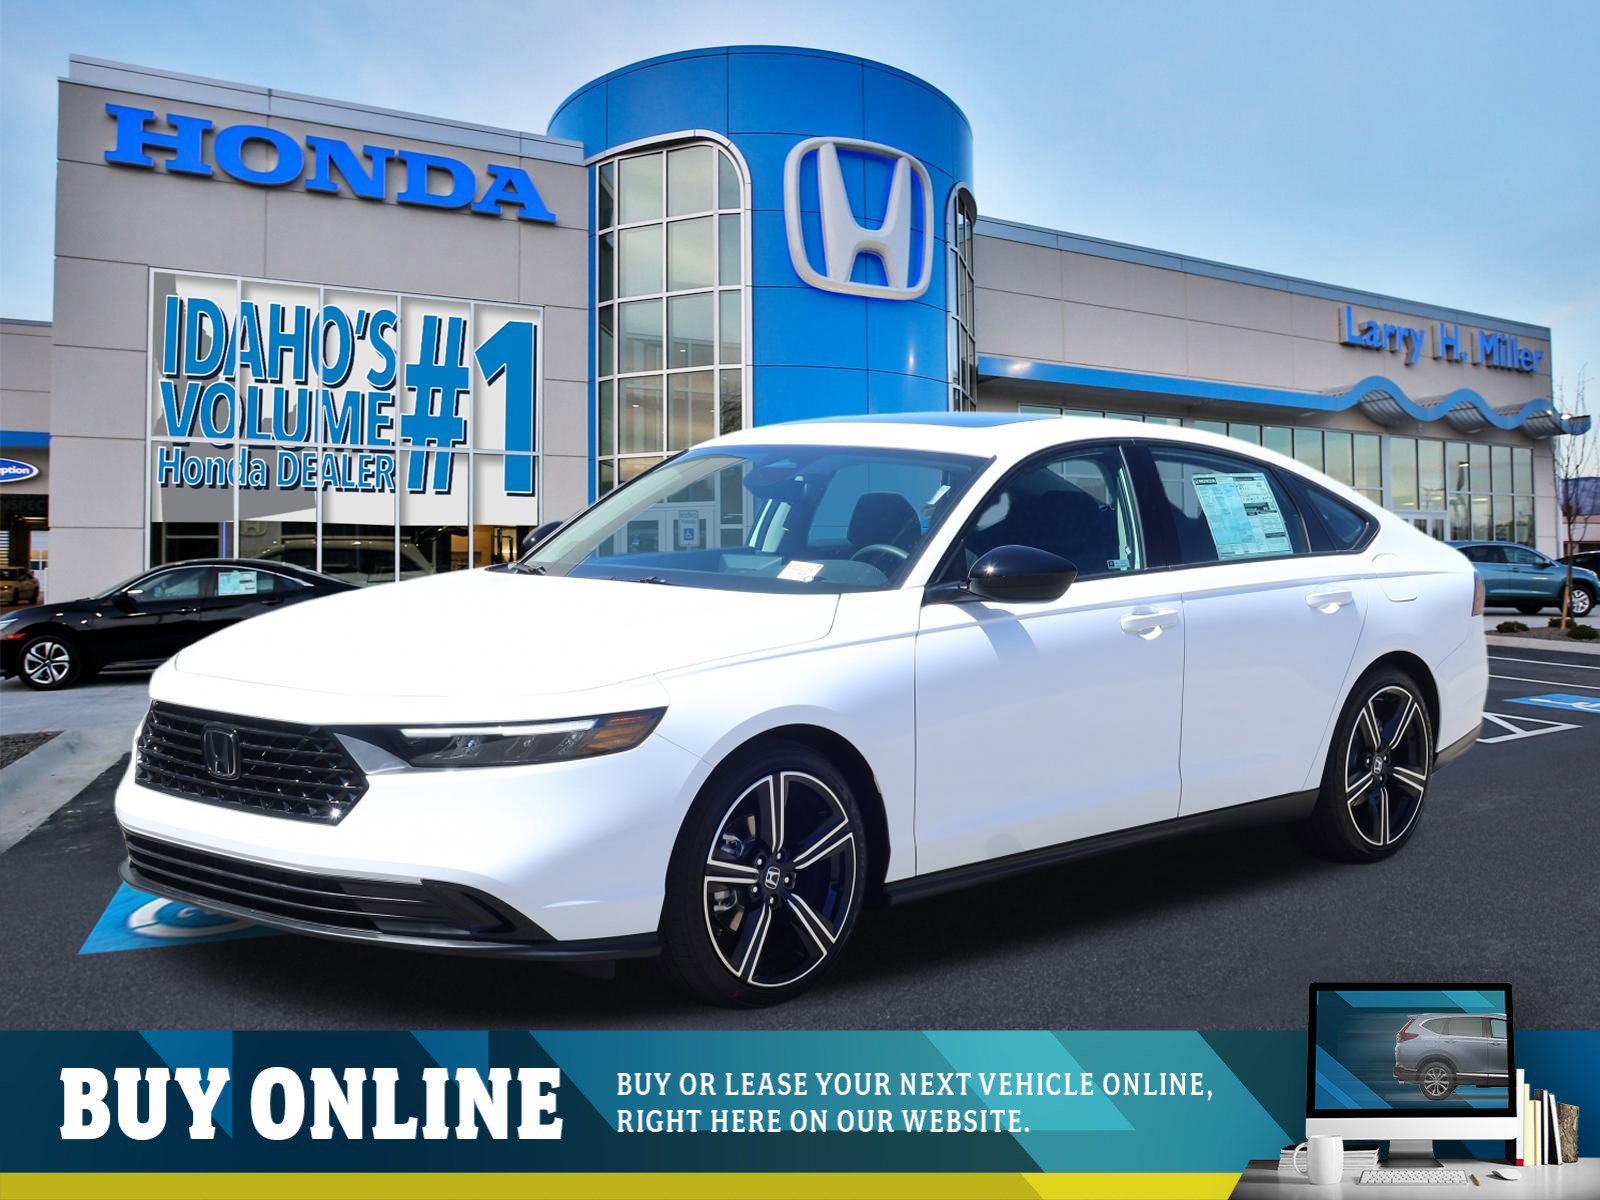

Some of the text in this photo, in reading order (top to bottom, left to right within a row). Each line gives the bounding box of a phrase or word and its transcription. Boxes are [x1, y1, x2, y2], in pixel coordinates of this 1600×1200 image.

[104, 103, 557, 223] HONDA
[162, 295, 399, 389] IDAHO'S
[1343, 305, 1544, 374] Larry H. Miller
[159, 380, 397, 450] VOLUME
[400, 314, 541, 496] #1
[0, 465, 30, 476] ption
[156, 446, 397, 493] Honda DEALER
